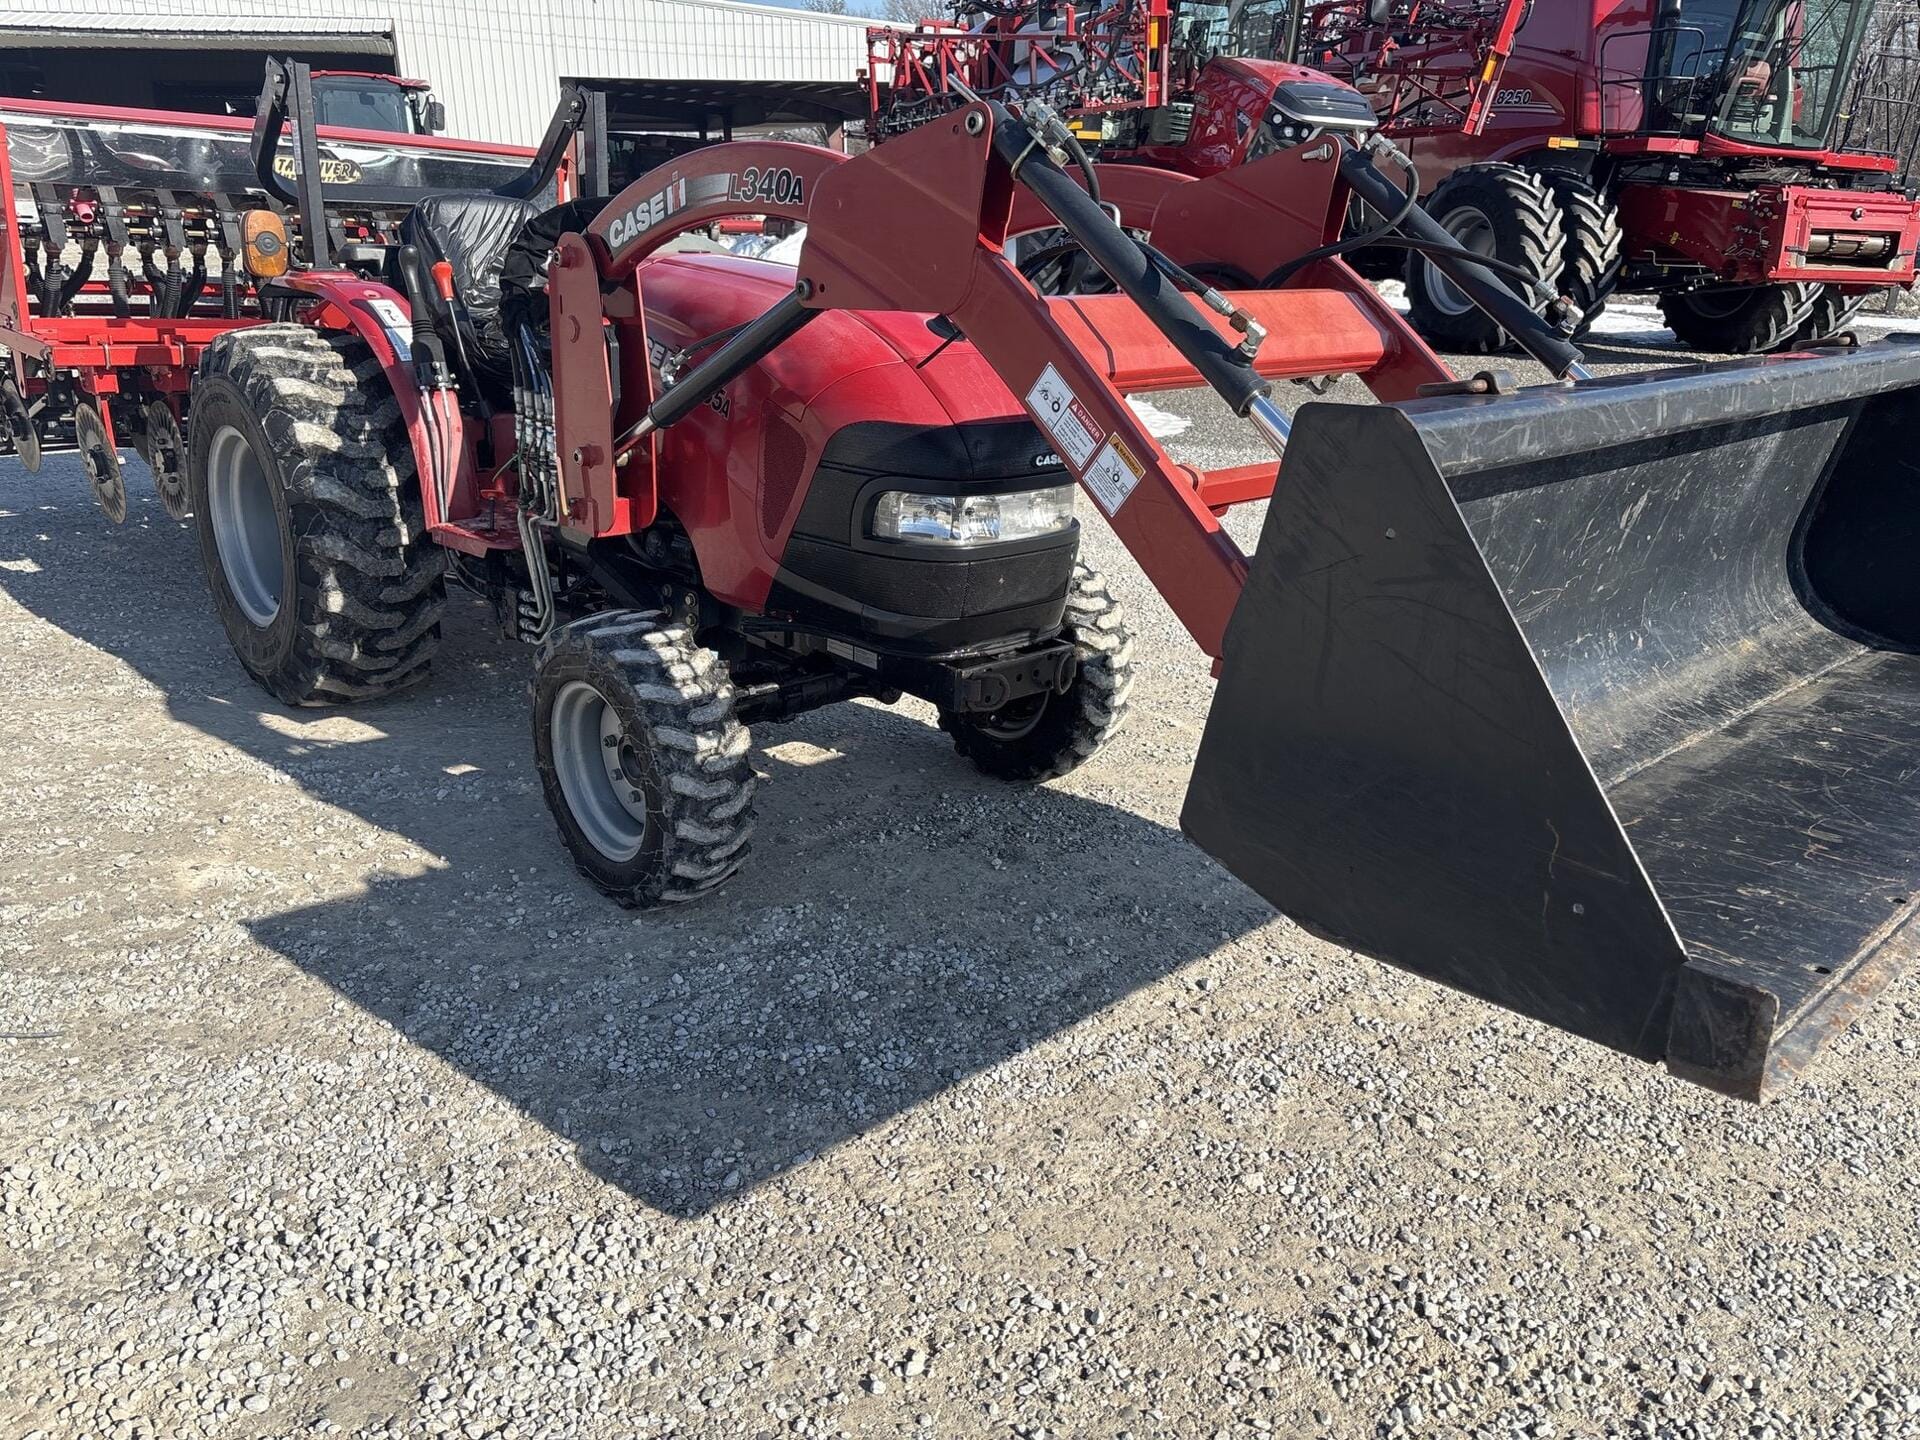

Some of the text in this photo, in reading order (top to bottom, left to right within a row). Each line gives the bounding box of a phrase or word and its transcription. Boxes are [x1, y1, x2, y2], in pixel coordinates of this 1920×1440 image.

[1496, 89, 1532, 104] 8250
[729, 167, 804, 205] L340A
[608, 191, 664, 248] CASE
[1077, 409, 1100, 440] DANGER
